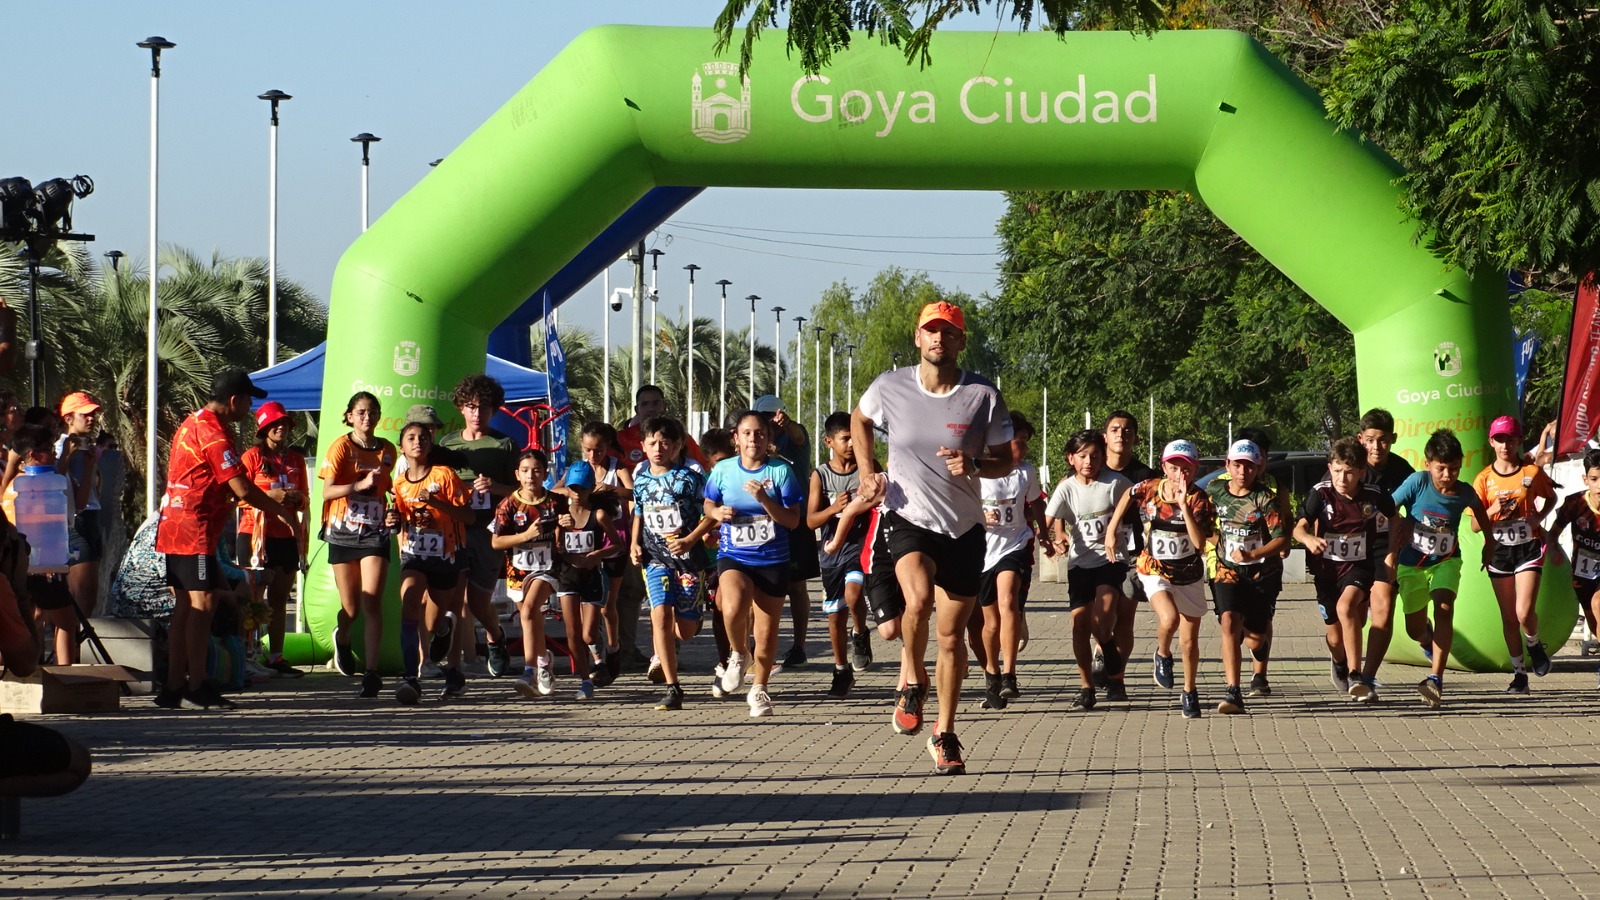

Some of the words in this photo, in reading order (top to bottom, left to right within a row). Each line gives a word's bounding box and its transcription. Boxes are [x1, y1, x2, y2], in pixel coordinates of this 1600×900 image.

[791, 73, 936, 138] Goya
[959, 73, 1157, 124] Ciudad
[351, 379, 393, 398] Goya
[1397, 388, 1441, 406] Goya
[1446, 380, 1500, 398] Ciudad
[1575, 403, 1592, 442] MODO
[351, 502, 379, 521] 211
[647, 513, 677, 529] 191
[735, 524, 769, 542] 203
[1083, 517, 1112, 537] 20
[1496, 525, 1527, 542] 205
[565, 532, 594, 549] 210
[1156, 538, 1189, 557] 202
[1328, 540, 1361, 557] 197
[1415, 532, 1448, 553] 196
[516, 549, 546, 567] 201
